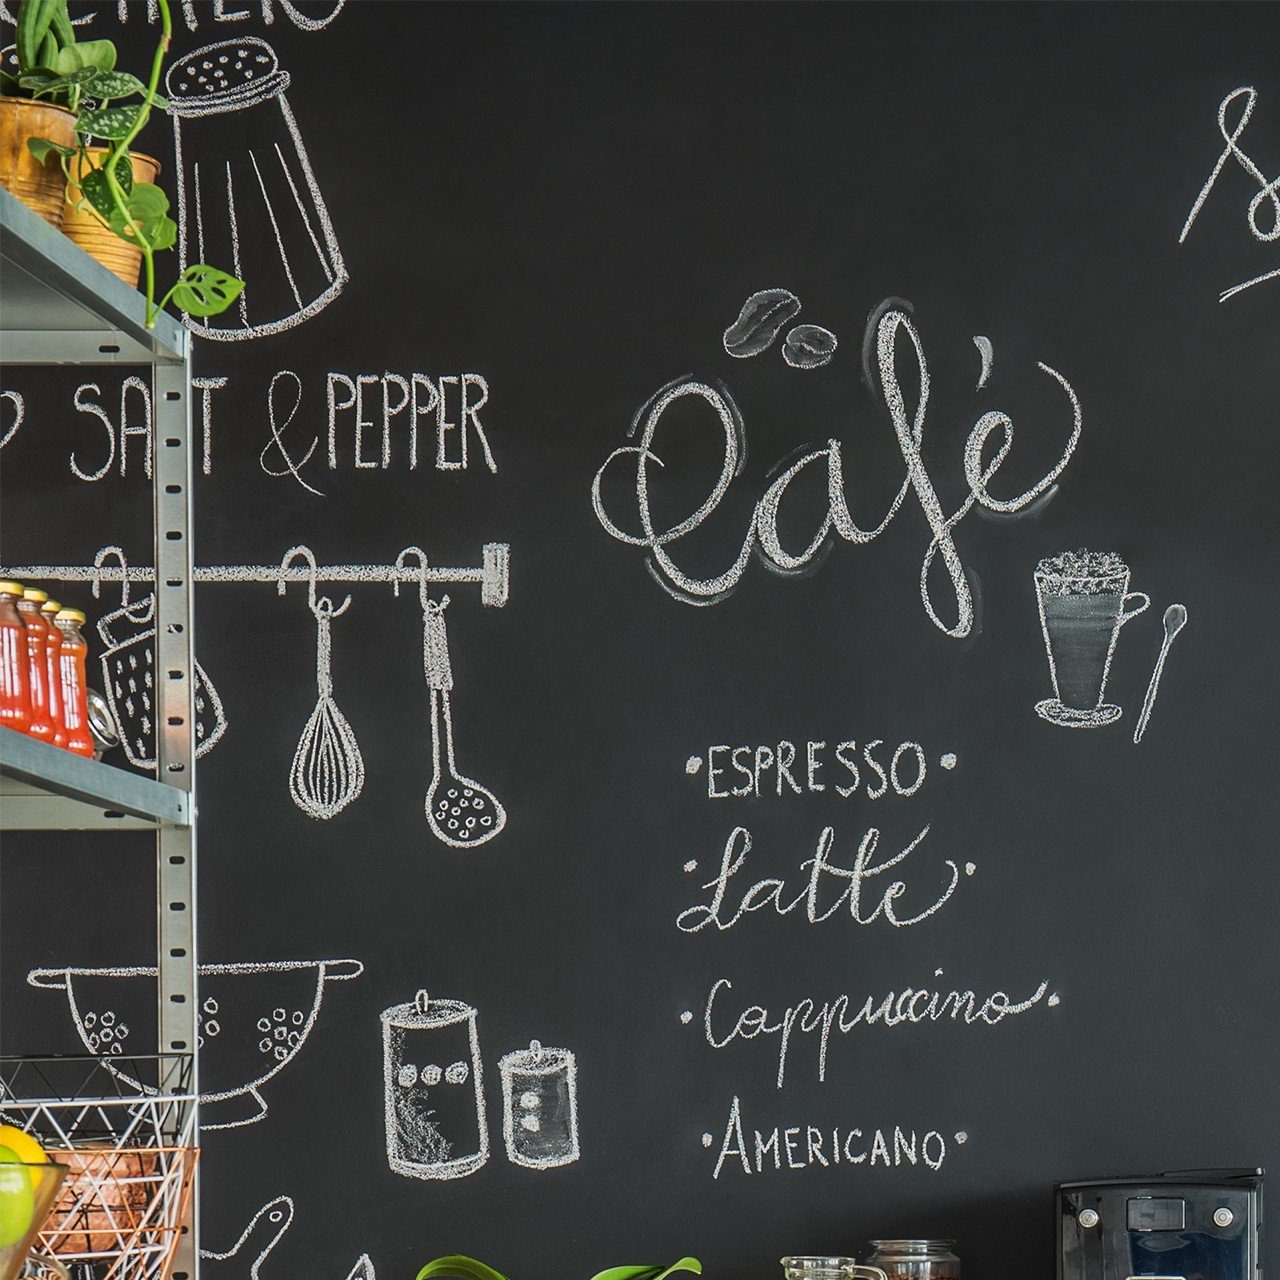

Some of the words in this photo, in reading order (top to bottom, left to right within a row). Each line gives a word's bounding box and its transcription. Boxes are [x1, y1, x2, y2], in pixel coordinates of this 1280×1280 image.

[70, 376, 228, 481] SAT
[260, 371, 325, 497] &
[326, 371, 498, 474] PEPPER
[707, 740, 927, 799] ESPRESSO
[676, 824, 958, 933] Latte
